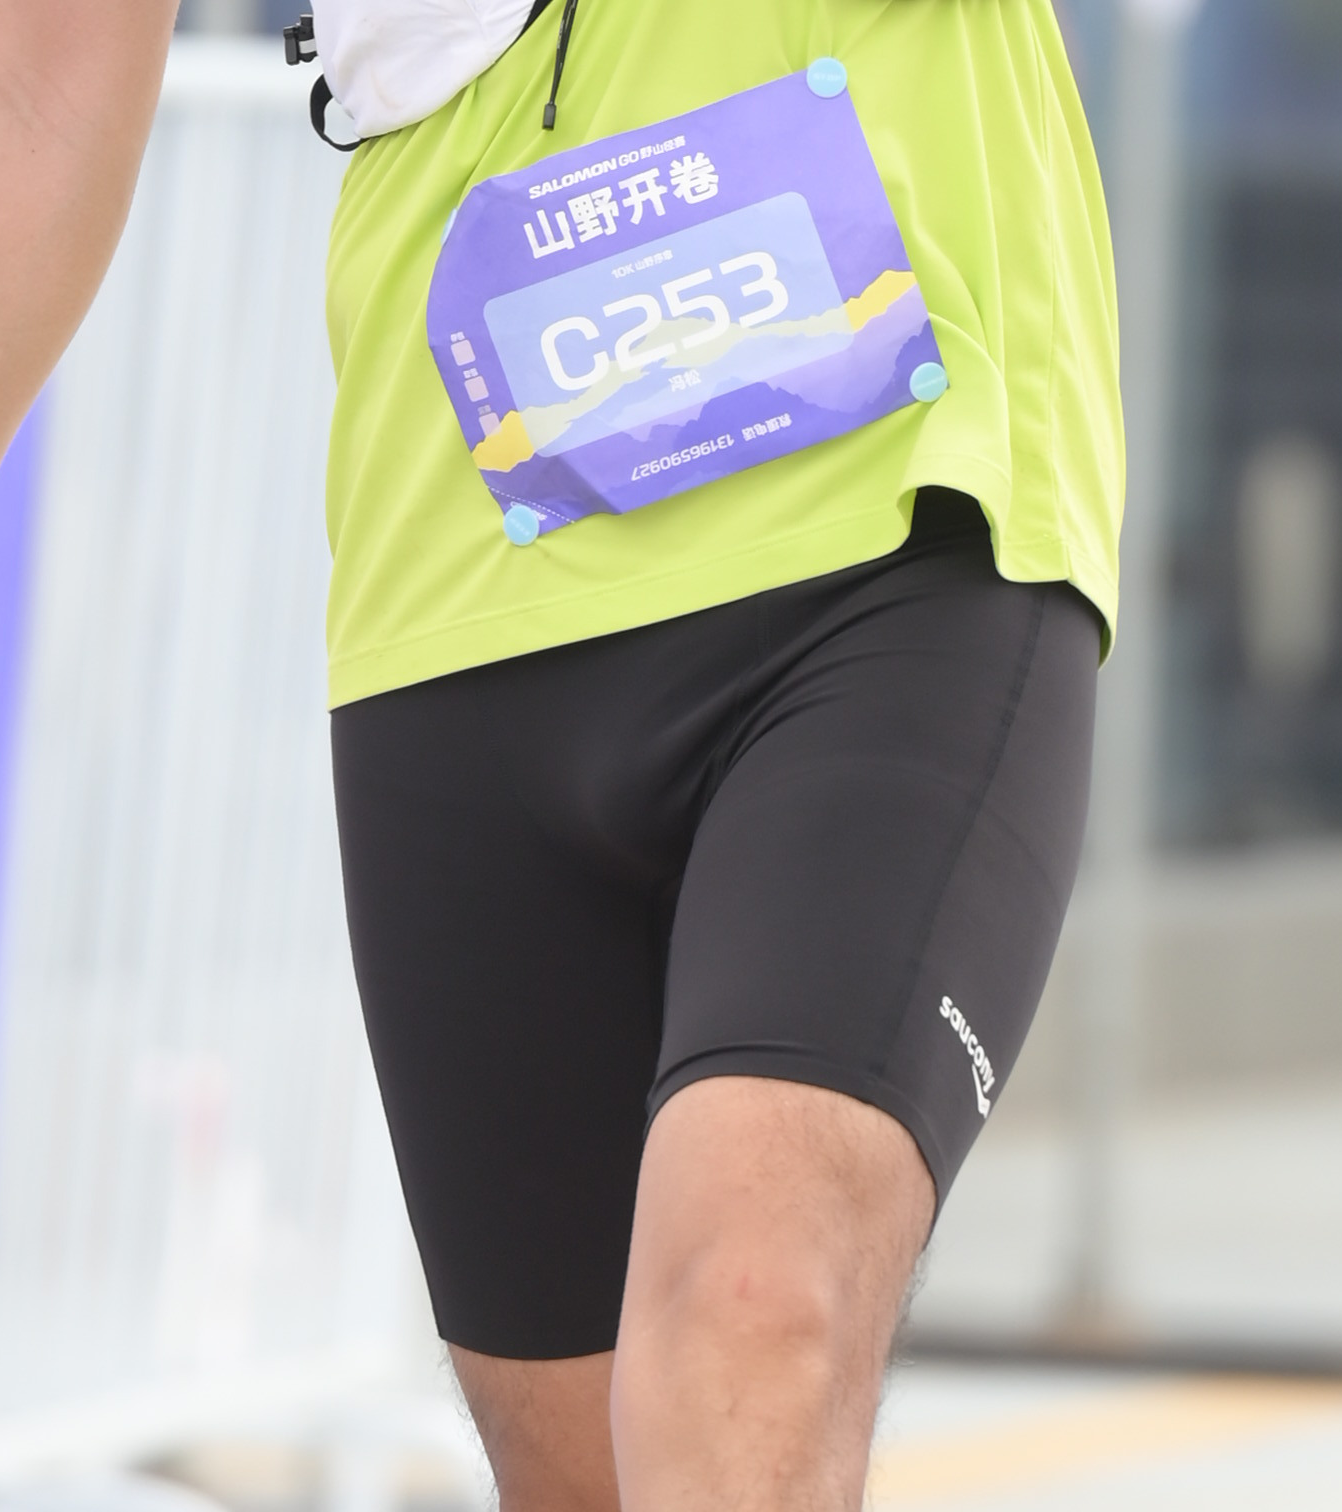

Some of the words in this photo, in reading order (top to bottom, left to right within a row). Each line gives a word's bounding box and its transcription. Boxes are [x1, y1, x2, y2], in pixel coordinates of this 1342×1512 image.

[524, 153, 719, 259] 山野开卷
[528, 158, 617, 199] SALOMON
[542, 252, 788, 390] C253
[631, 434, 734, 481] 13196590927
[939, 995, 996, 1094] saucony
